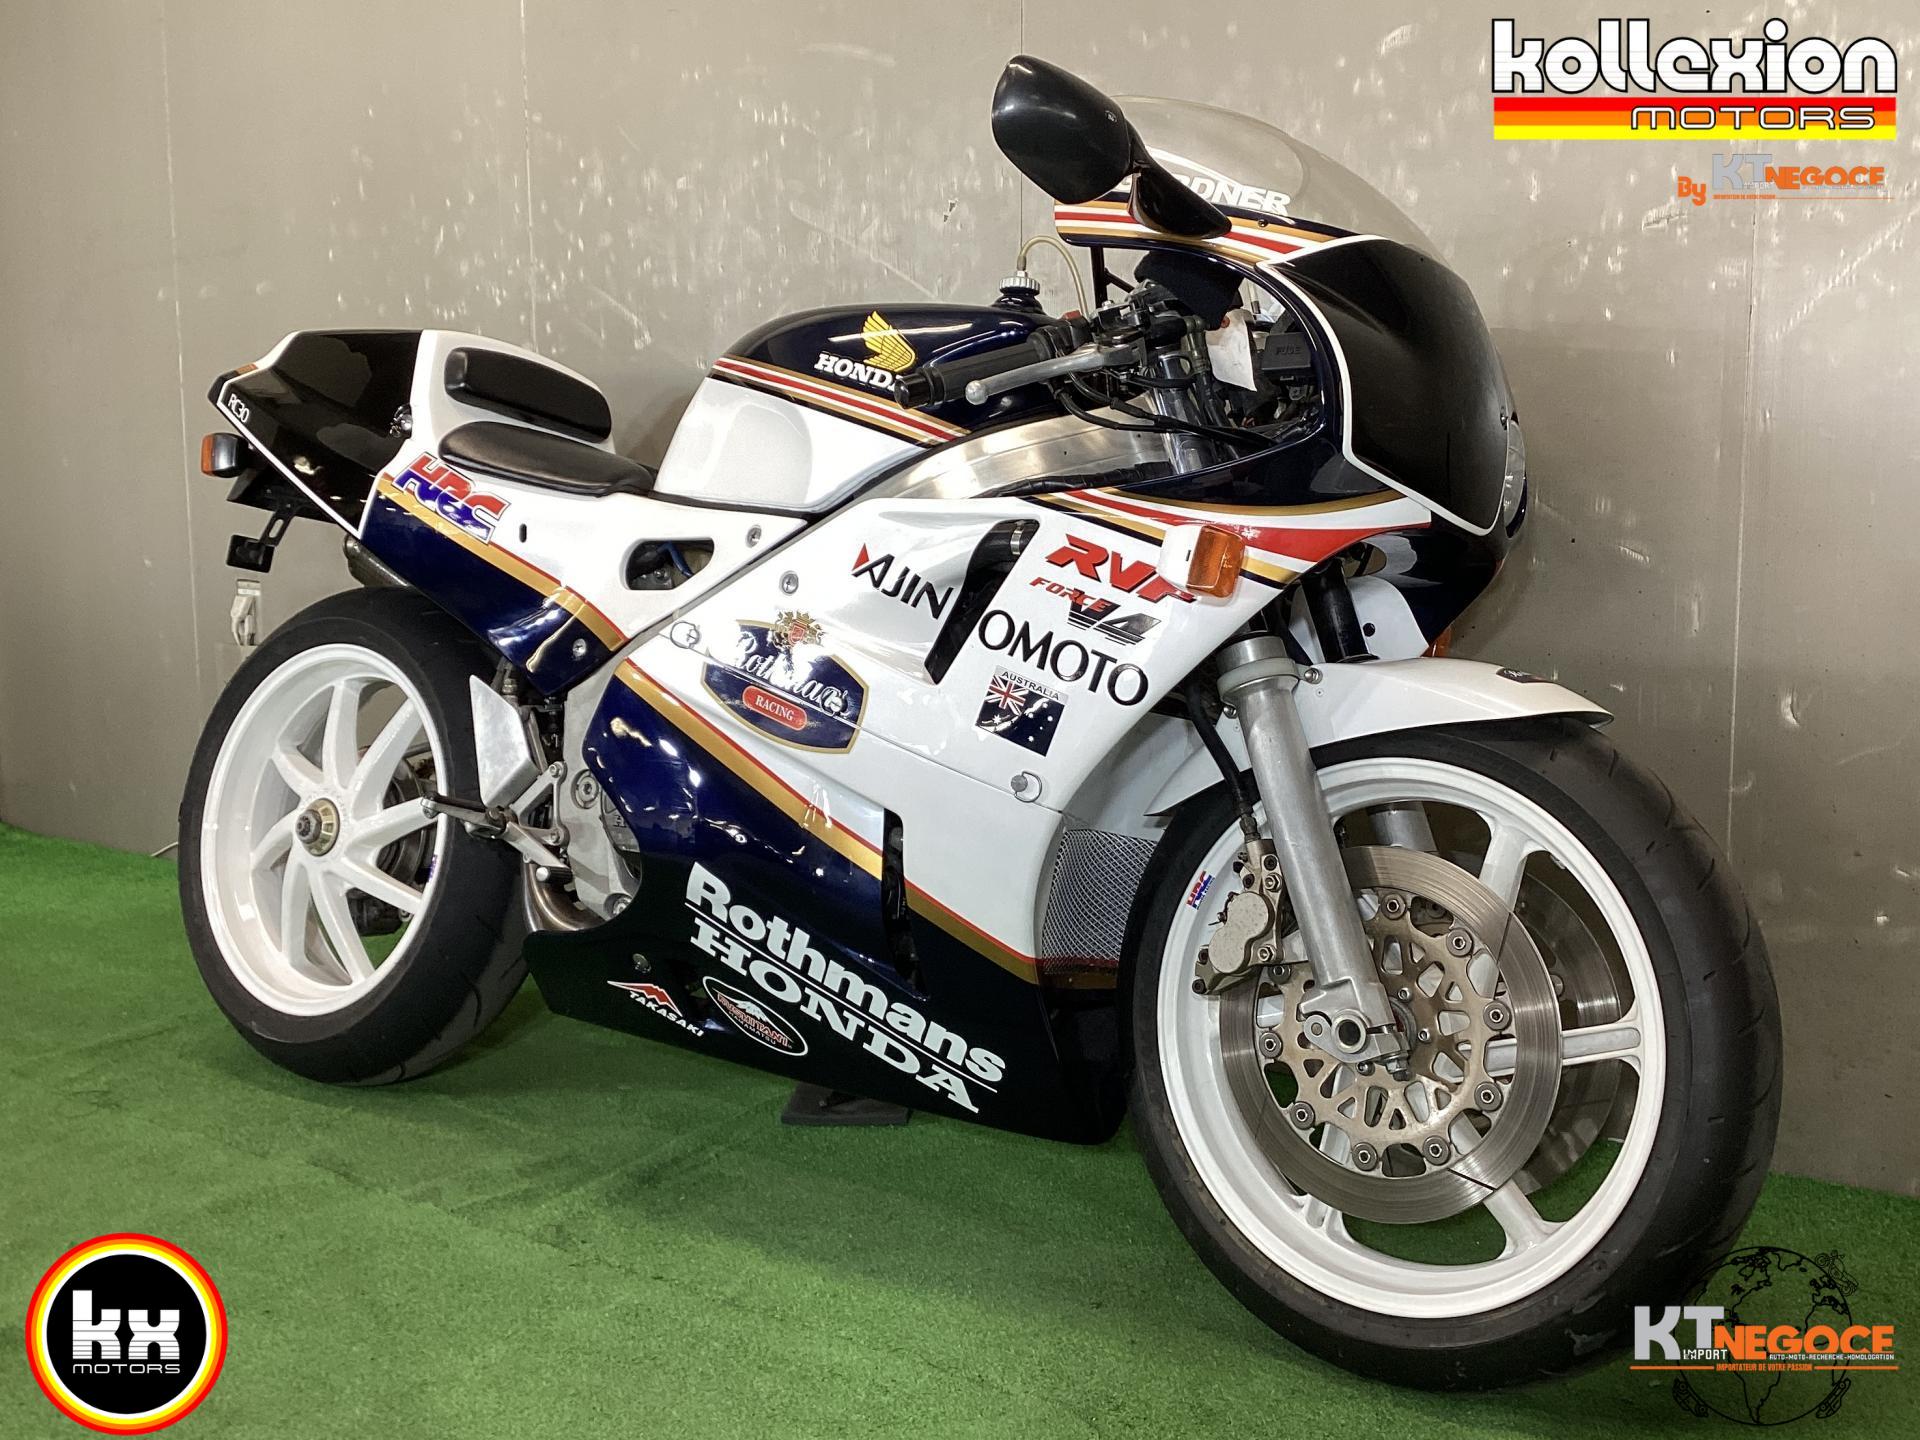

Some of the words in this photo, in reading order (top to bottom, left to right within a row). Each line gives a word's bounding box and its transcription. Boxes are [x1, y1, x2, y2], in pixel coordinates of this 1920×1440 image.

[755, 694, 795, 721] RACING
[1002, 671, 1060, 700] AUSTRALIA
[685, 861, 1006, 1082] Rothmans
[629, 991, 705, 1037] TAKASAKI
[689, 917, 979, 1113] HONDA
